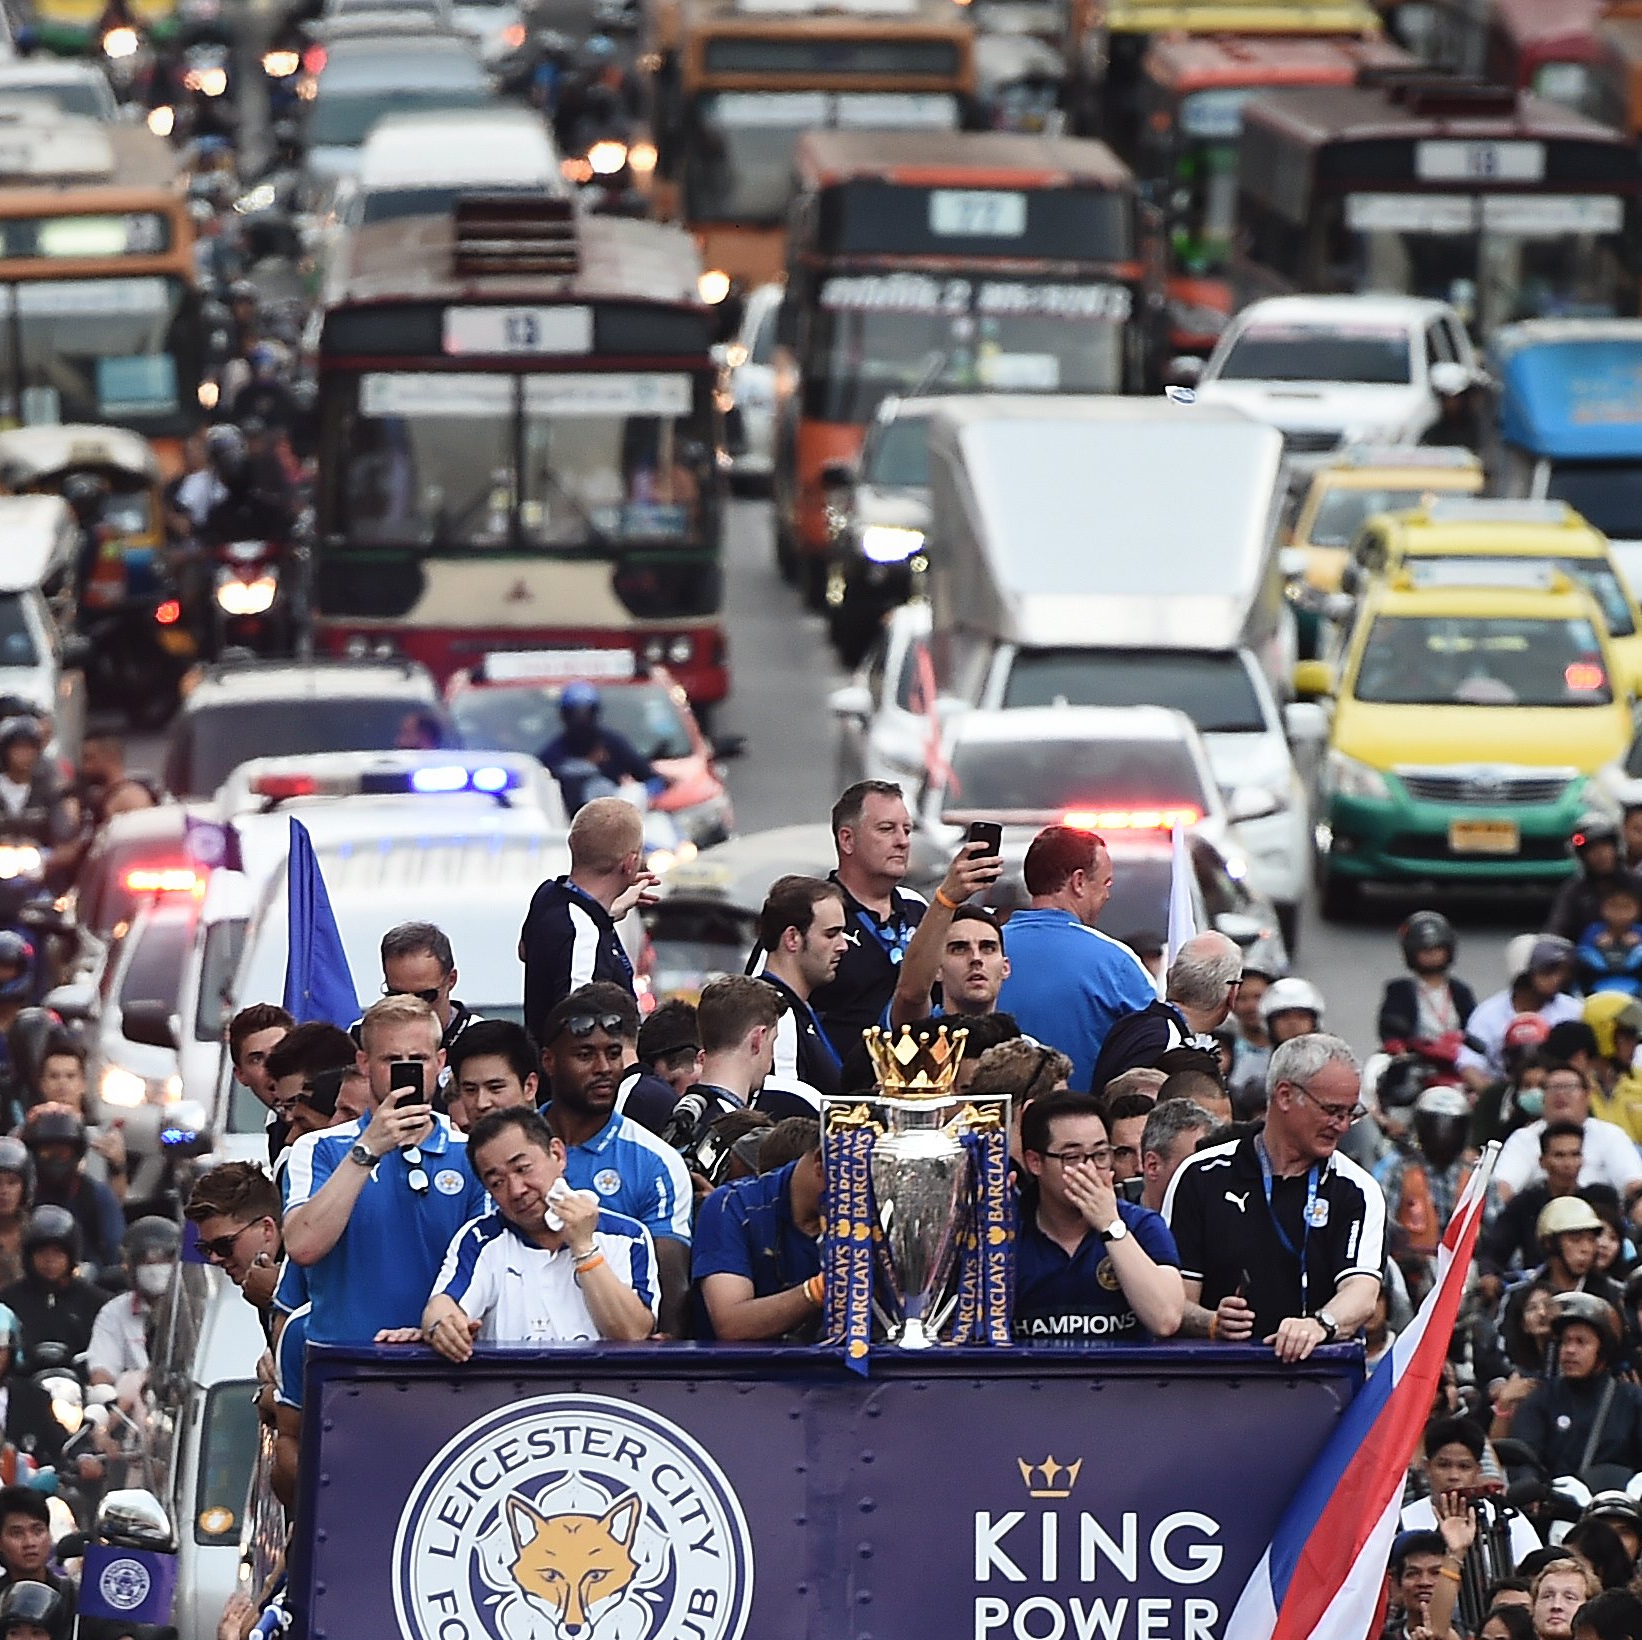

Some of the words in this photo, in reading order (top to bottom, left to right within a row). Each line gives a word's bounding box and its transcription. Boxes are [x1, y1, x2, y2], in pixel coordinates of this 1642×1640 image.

[853, 1131, 872, 1219] BARCLAYS
[988, 1132, 1005, 1222] BARCLAYS
[850, 1247, 870, 1337] BARCLAYS
[988, 1252, 1007, 1341] BARCLAYS
[1010, 1309, 1138, 1336] HAMPIONS
[428, 1425, 648, 1560] LEICESTER
[650, 1463, 721, 1560] CITY
[974, 1510, 1225, 1584] KING
